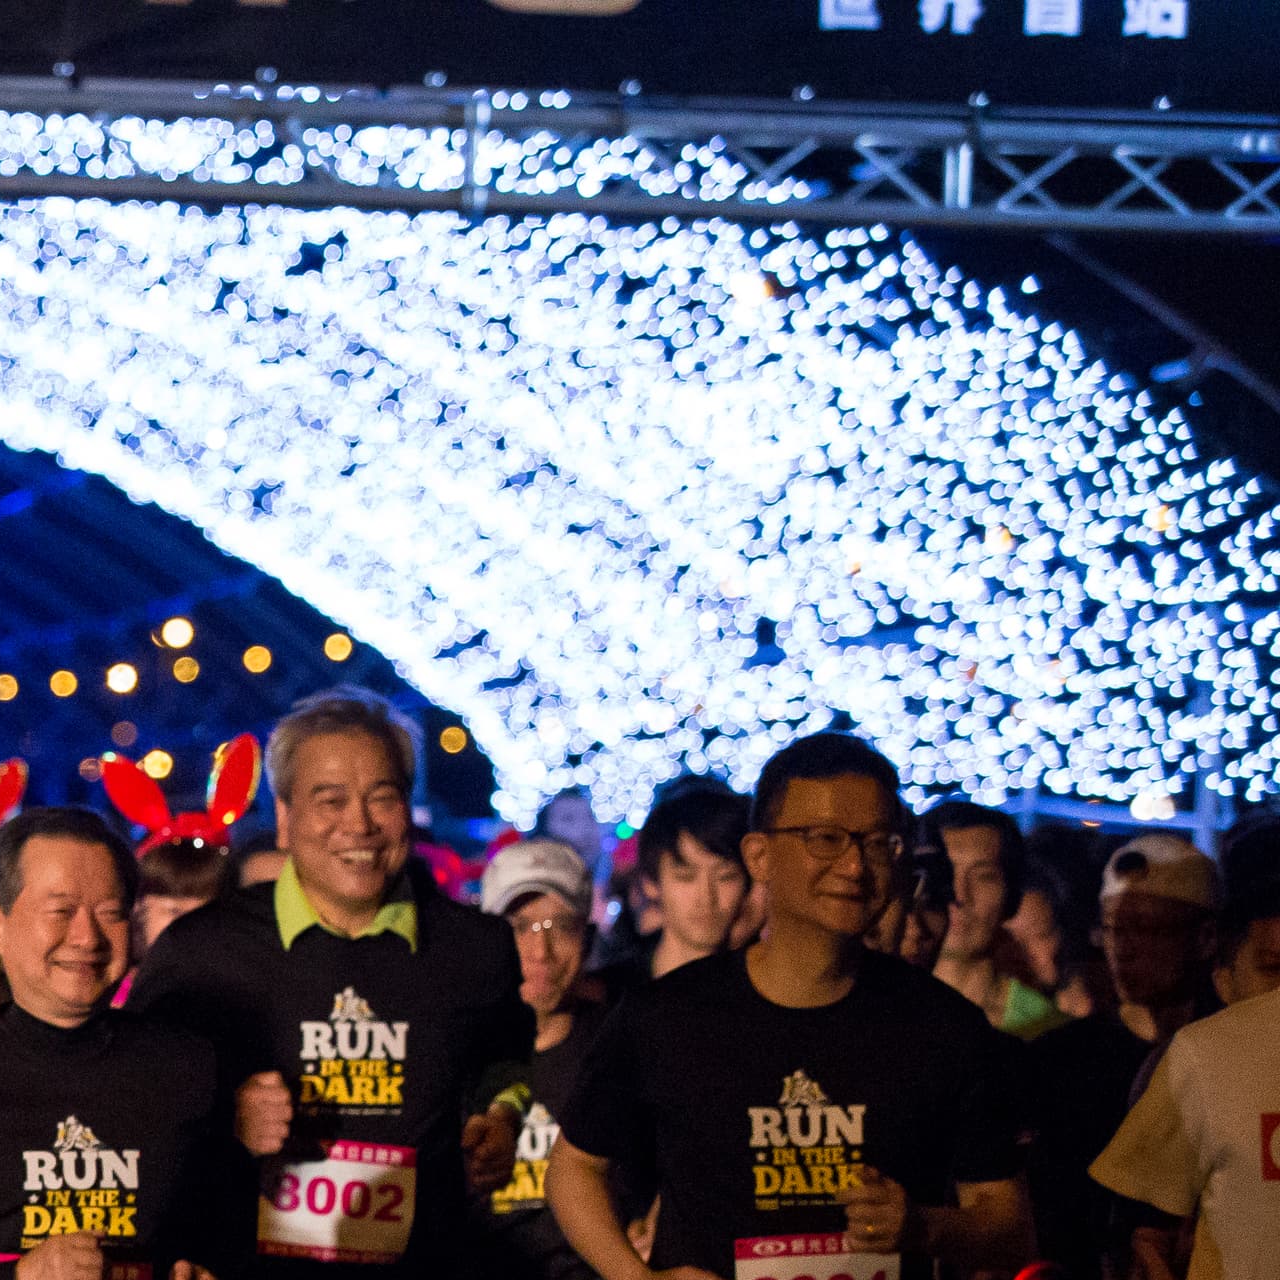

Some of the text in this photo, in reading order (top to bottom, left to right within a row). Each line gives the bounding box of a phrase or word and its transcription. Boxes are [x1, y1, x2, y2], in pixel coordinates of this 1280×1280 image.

[300, 1021, 409, 1060] RUN
[320, 1059, 387, 1076] IN THE
[300, 1075, 405, 1105] DARK
[747, 1104, 866, 1148] RUN
[22, 1150, 140, 1190] RUN
[772, 1147, 845, 1165] IN THE
[752, 1163, 864, 1195] DARK
[46, 1190, 120, 1207] IN THE
[273, 1172, 405, 1222] 8002
[22, 1205, 138, 1236] DARK
